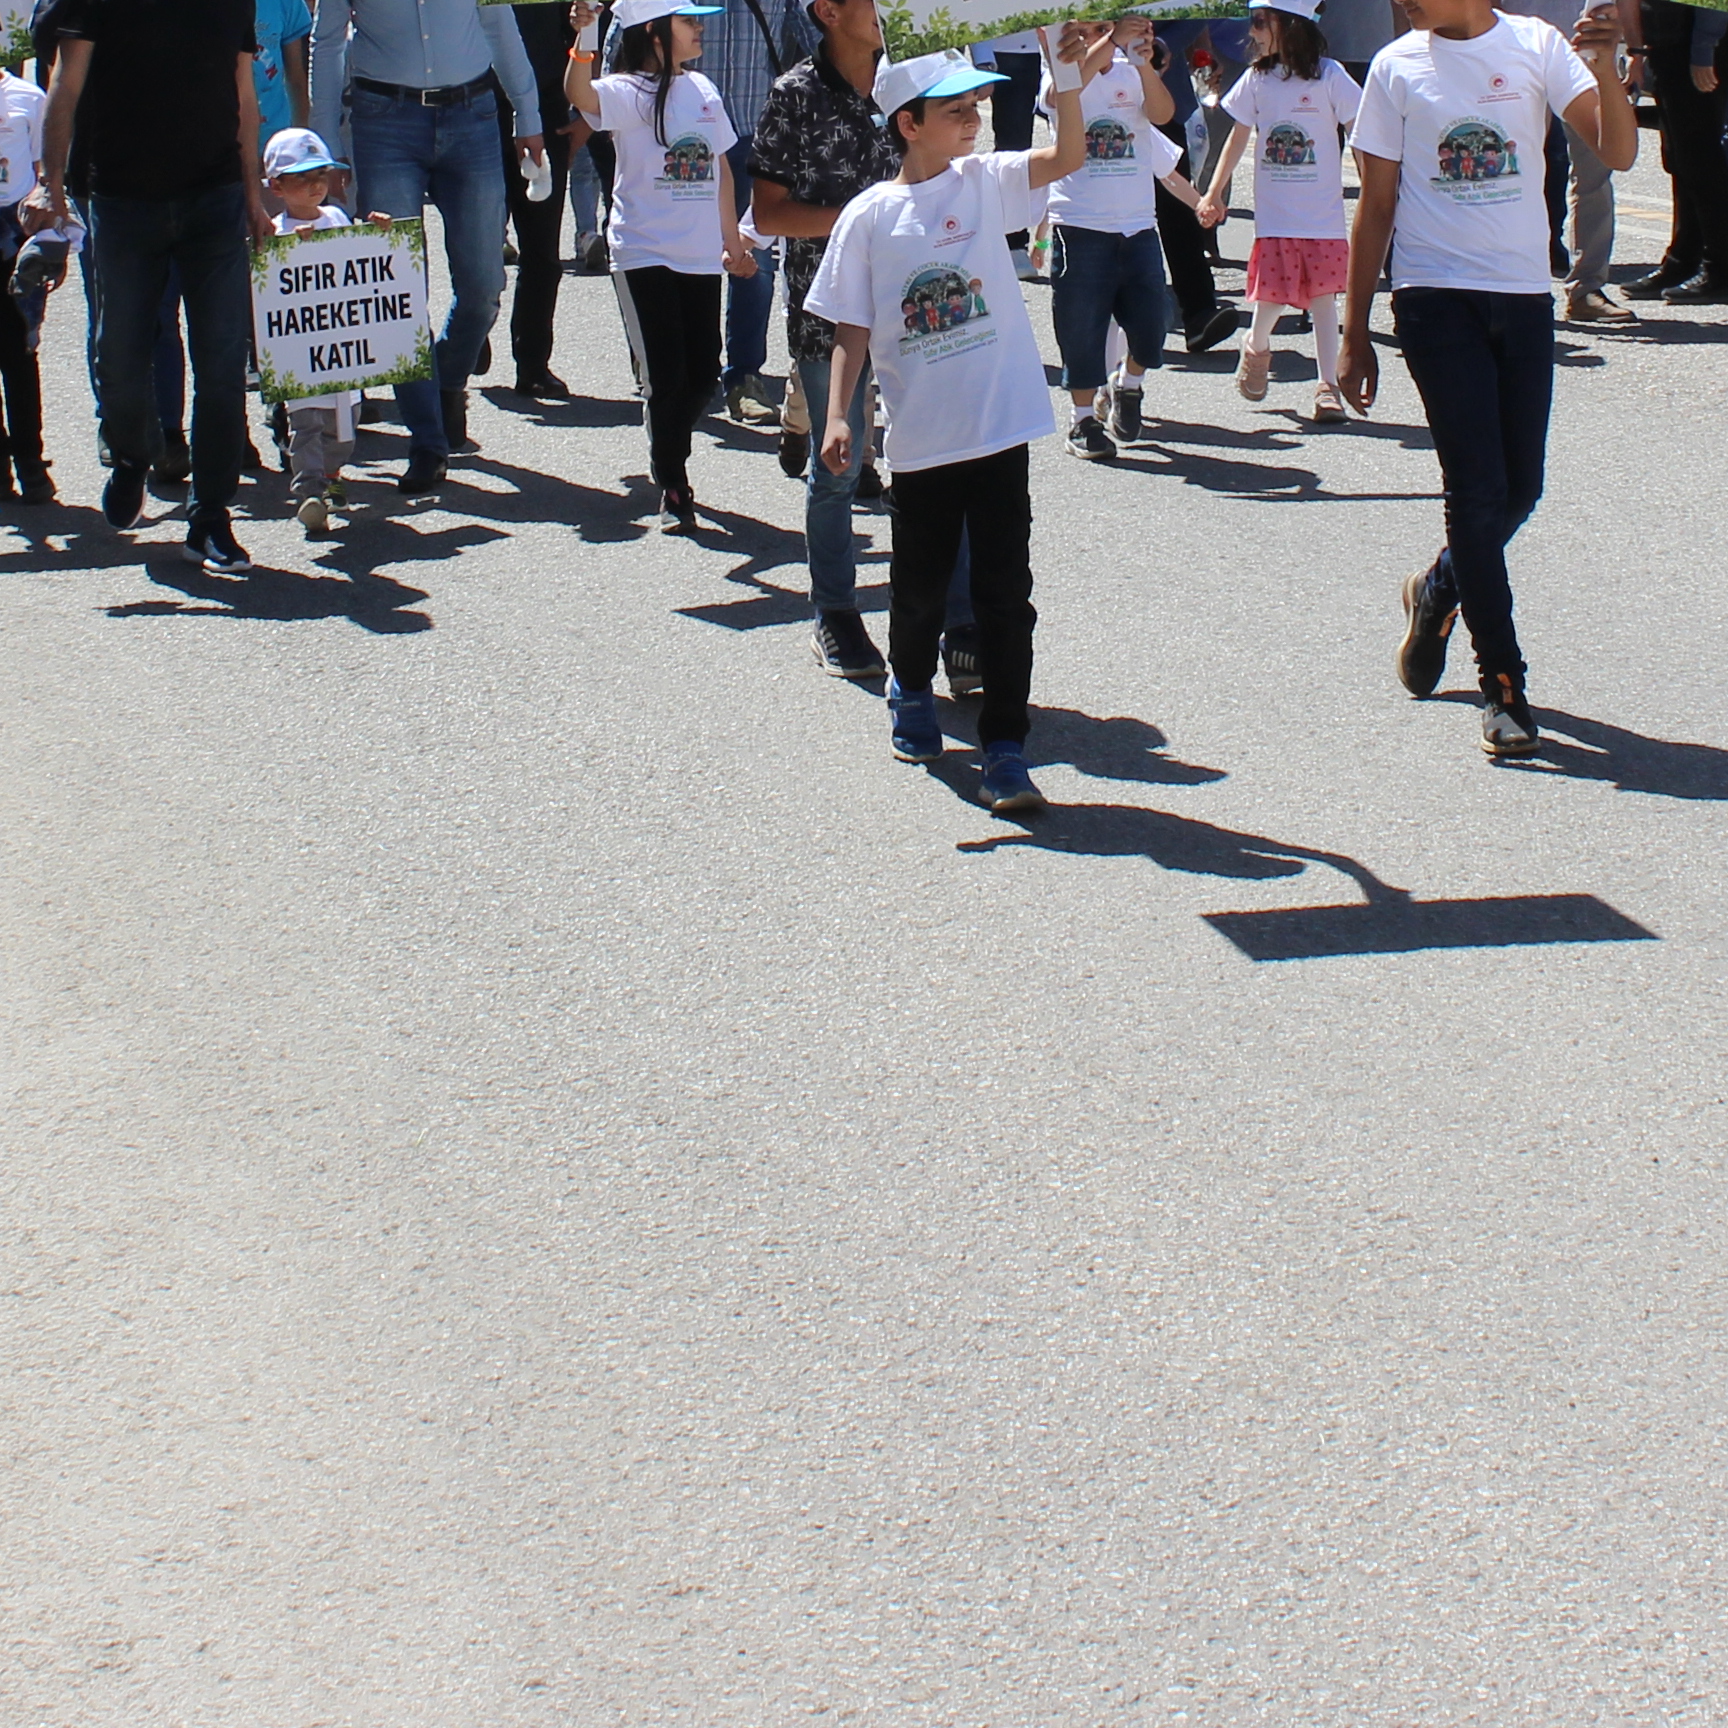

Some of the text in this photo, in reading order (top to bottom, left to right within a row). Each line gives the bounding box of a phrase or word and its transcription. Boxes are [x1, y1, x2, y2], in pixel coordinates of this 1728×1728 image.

[279, 254, 395, 296] SIFIR ATIK
[267, 288, 413, 339] HAREKETİNE
[309, 338, 376, 373] KATIL
